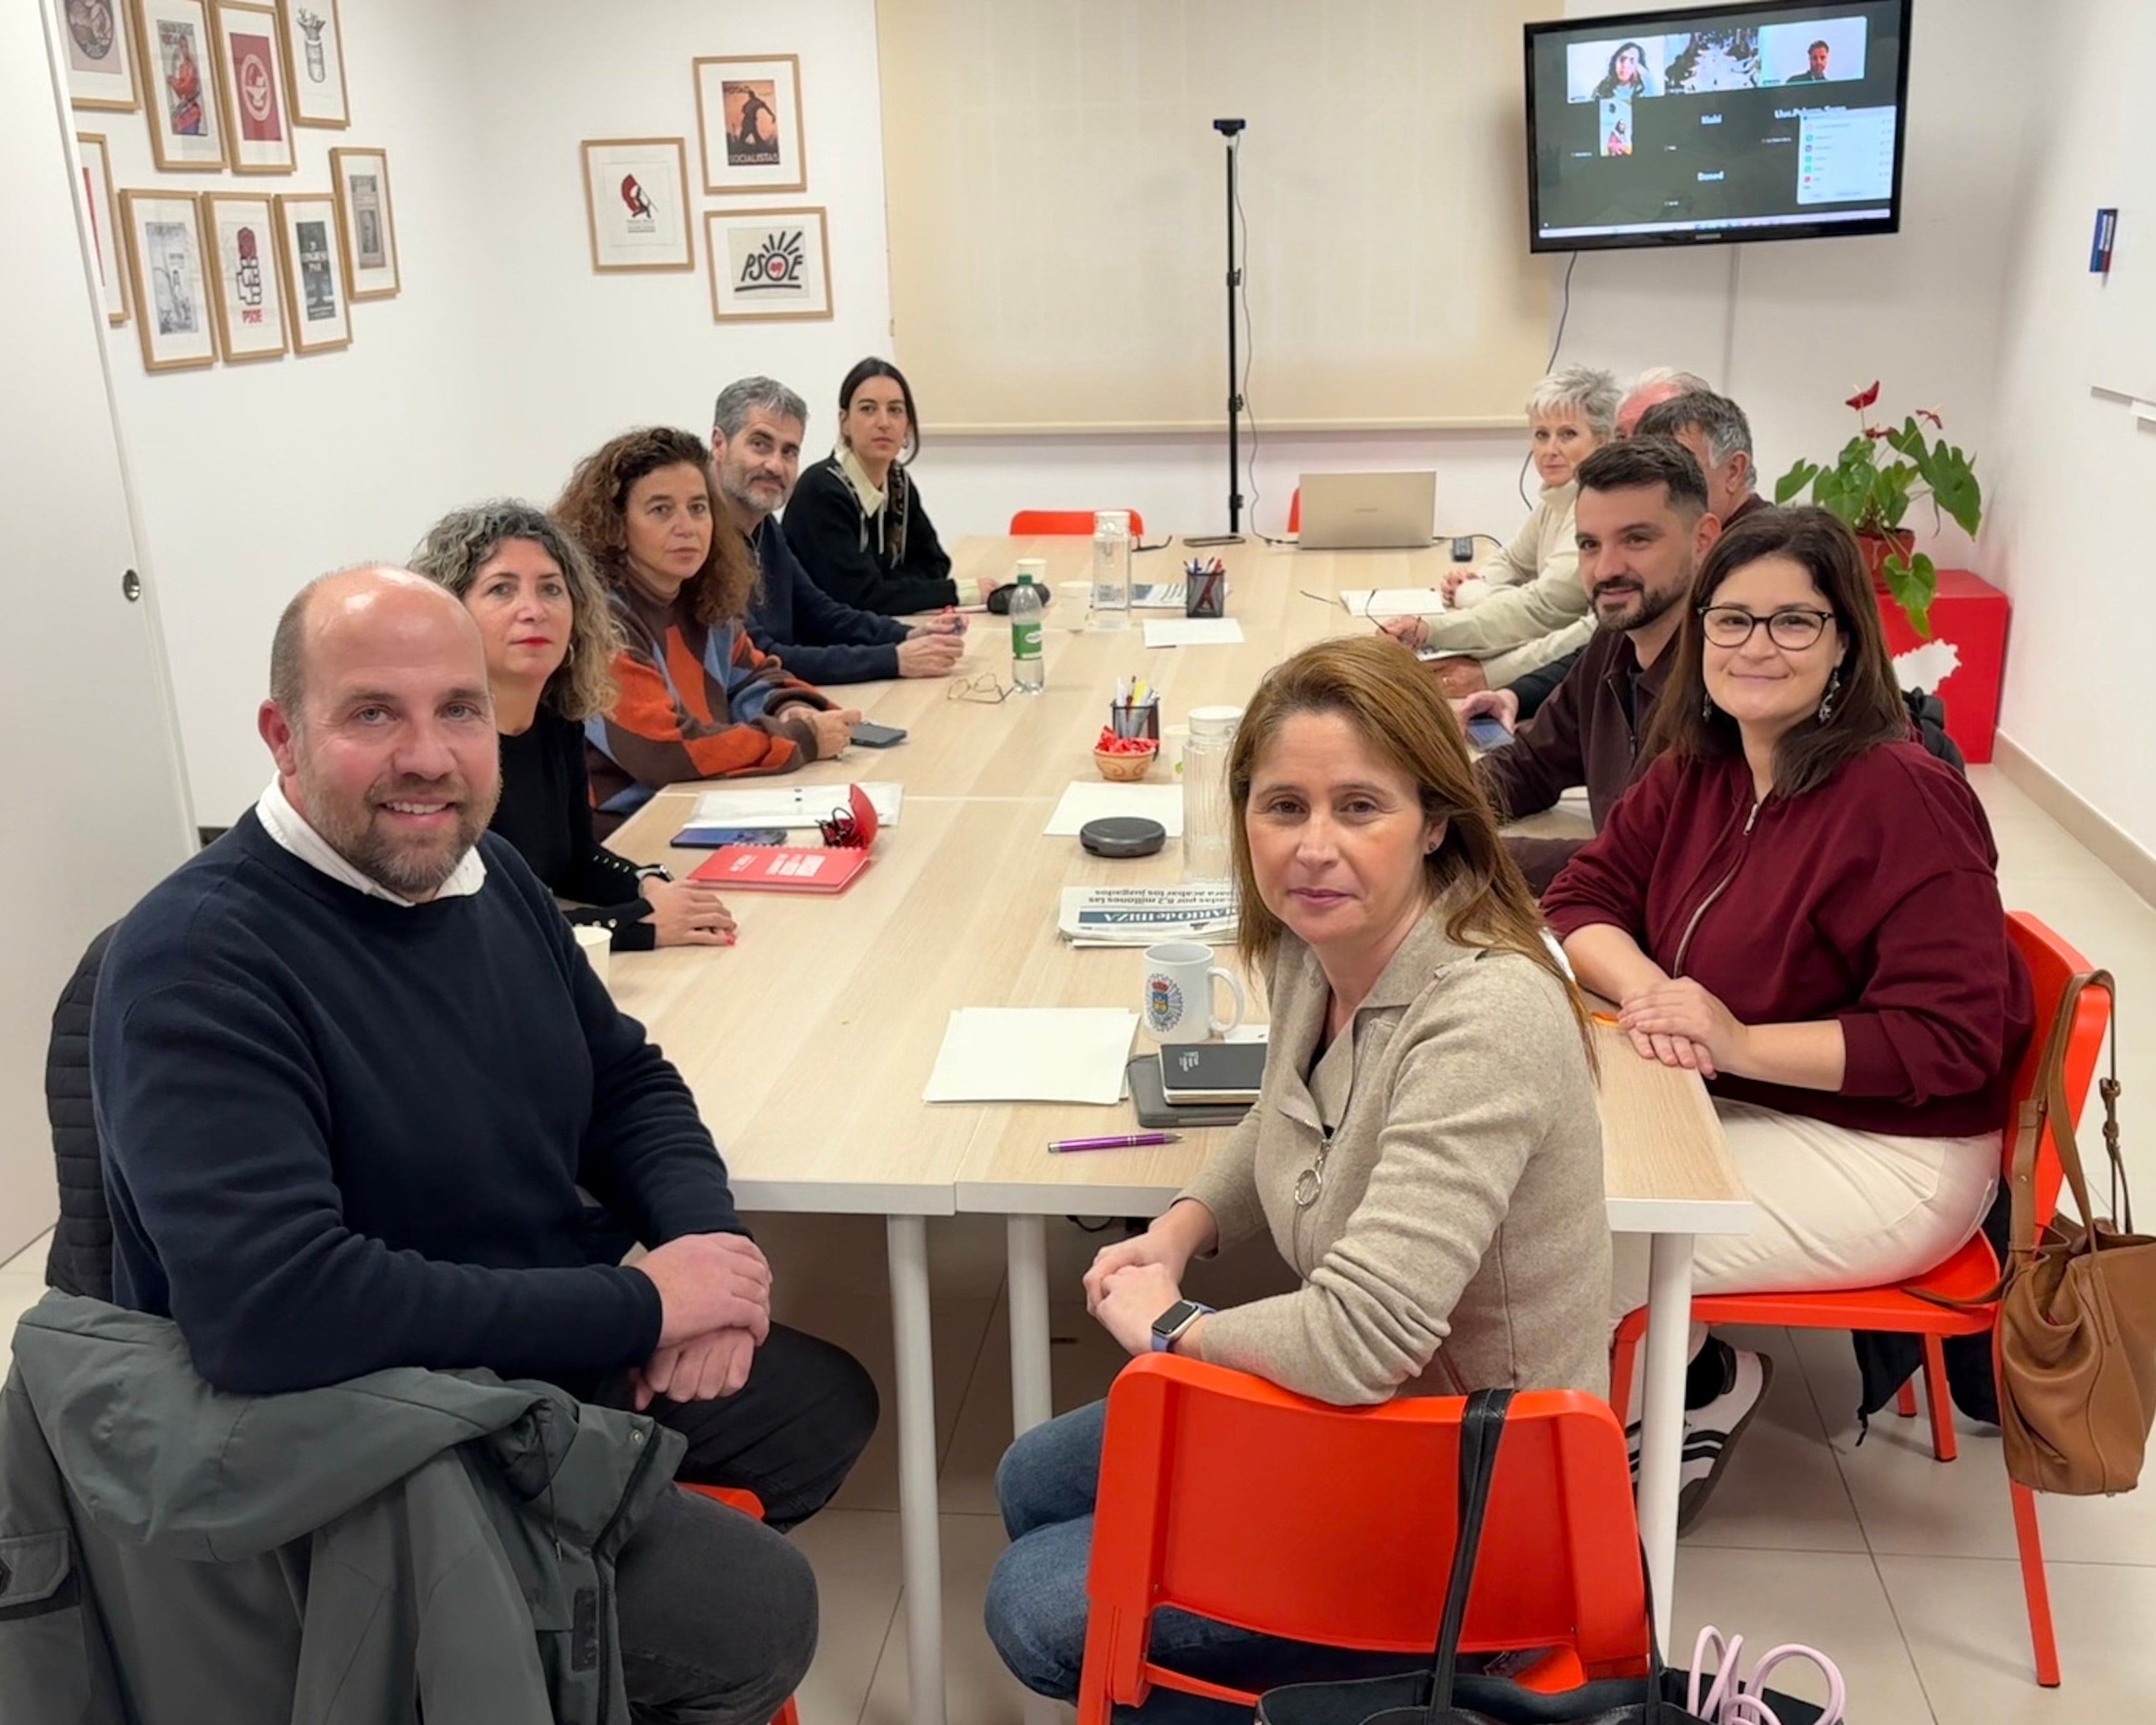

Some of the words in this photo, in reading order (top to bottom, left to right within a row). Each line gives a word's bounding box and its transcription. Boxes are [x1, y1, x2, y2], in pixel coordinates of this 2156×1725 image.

[741, 253, 803, 282] PSOE
[242, 309, 263, 324] PSOE
[1104, 912, 1154, 922] IBIZA
[1156, 912, 1176, 921] de
